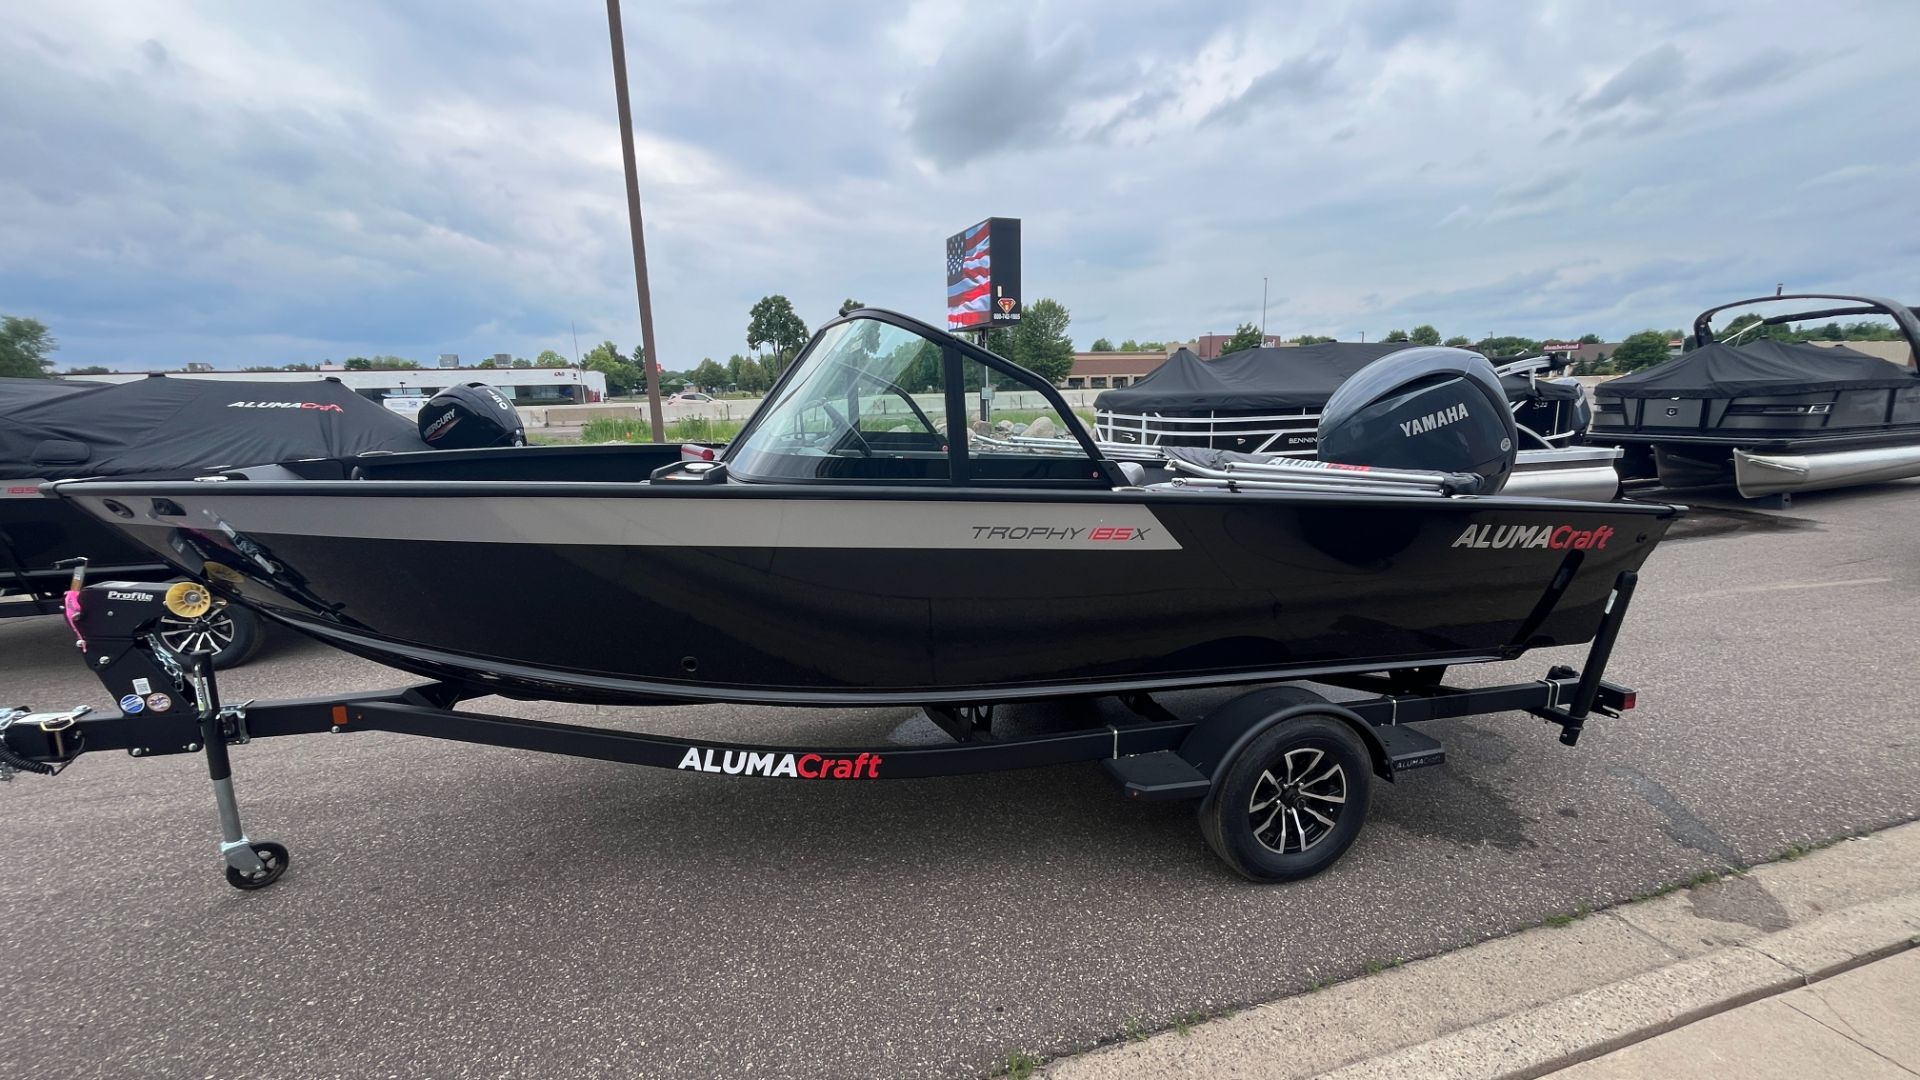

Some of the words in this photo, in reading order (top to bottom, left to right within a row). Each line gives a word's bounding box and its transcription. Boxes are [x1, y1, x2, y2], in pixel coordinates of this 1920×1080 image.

[423, 408, 456, 435] MERCURY
[1399, 402, 1469, 437] YAMAHA
[972, 526, 1086, 540] TROPHY
[1087, 527, 1152, 541] 185X
[1451, 523, 1616, 549] ALUMACraft
[107, 590, 154, 602] Profile
[677, 747, 882, 780] ALUMACraft
